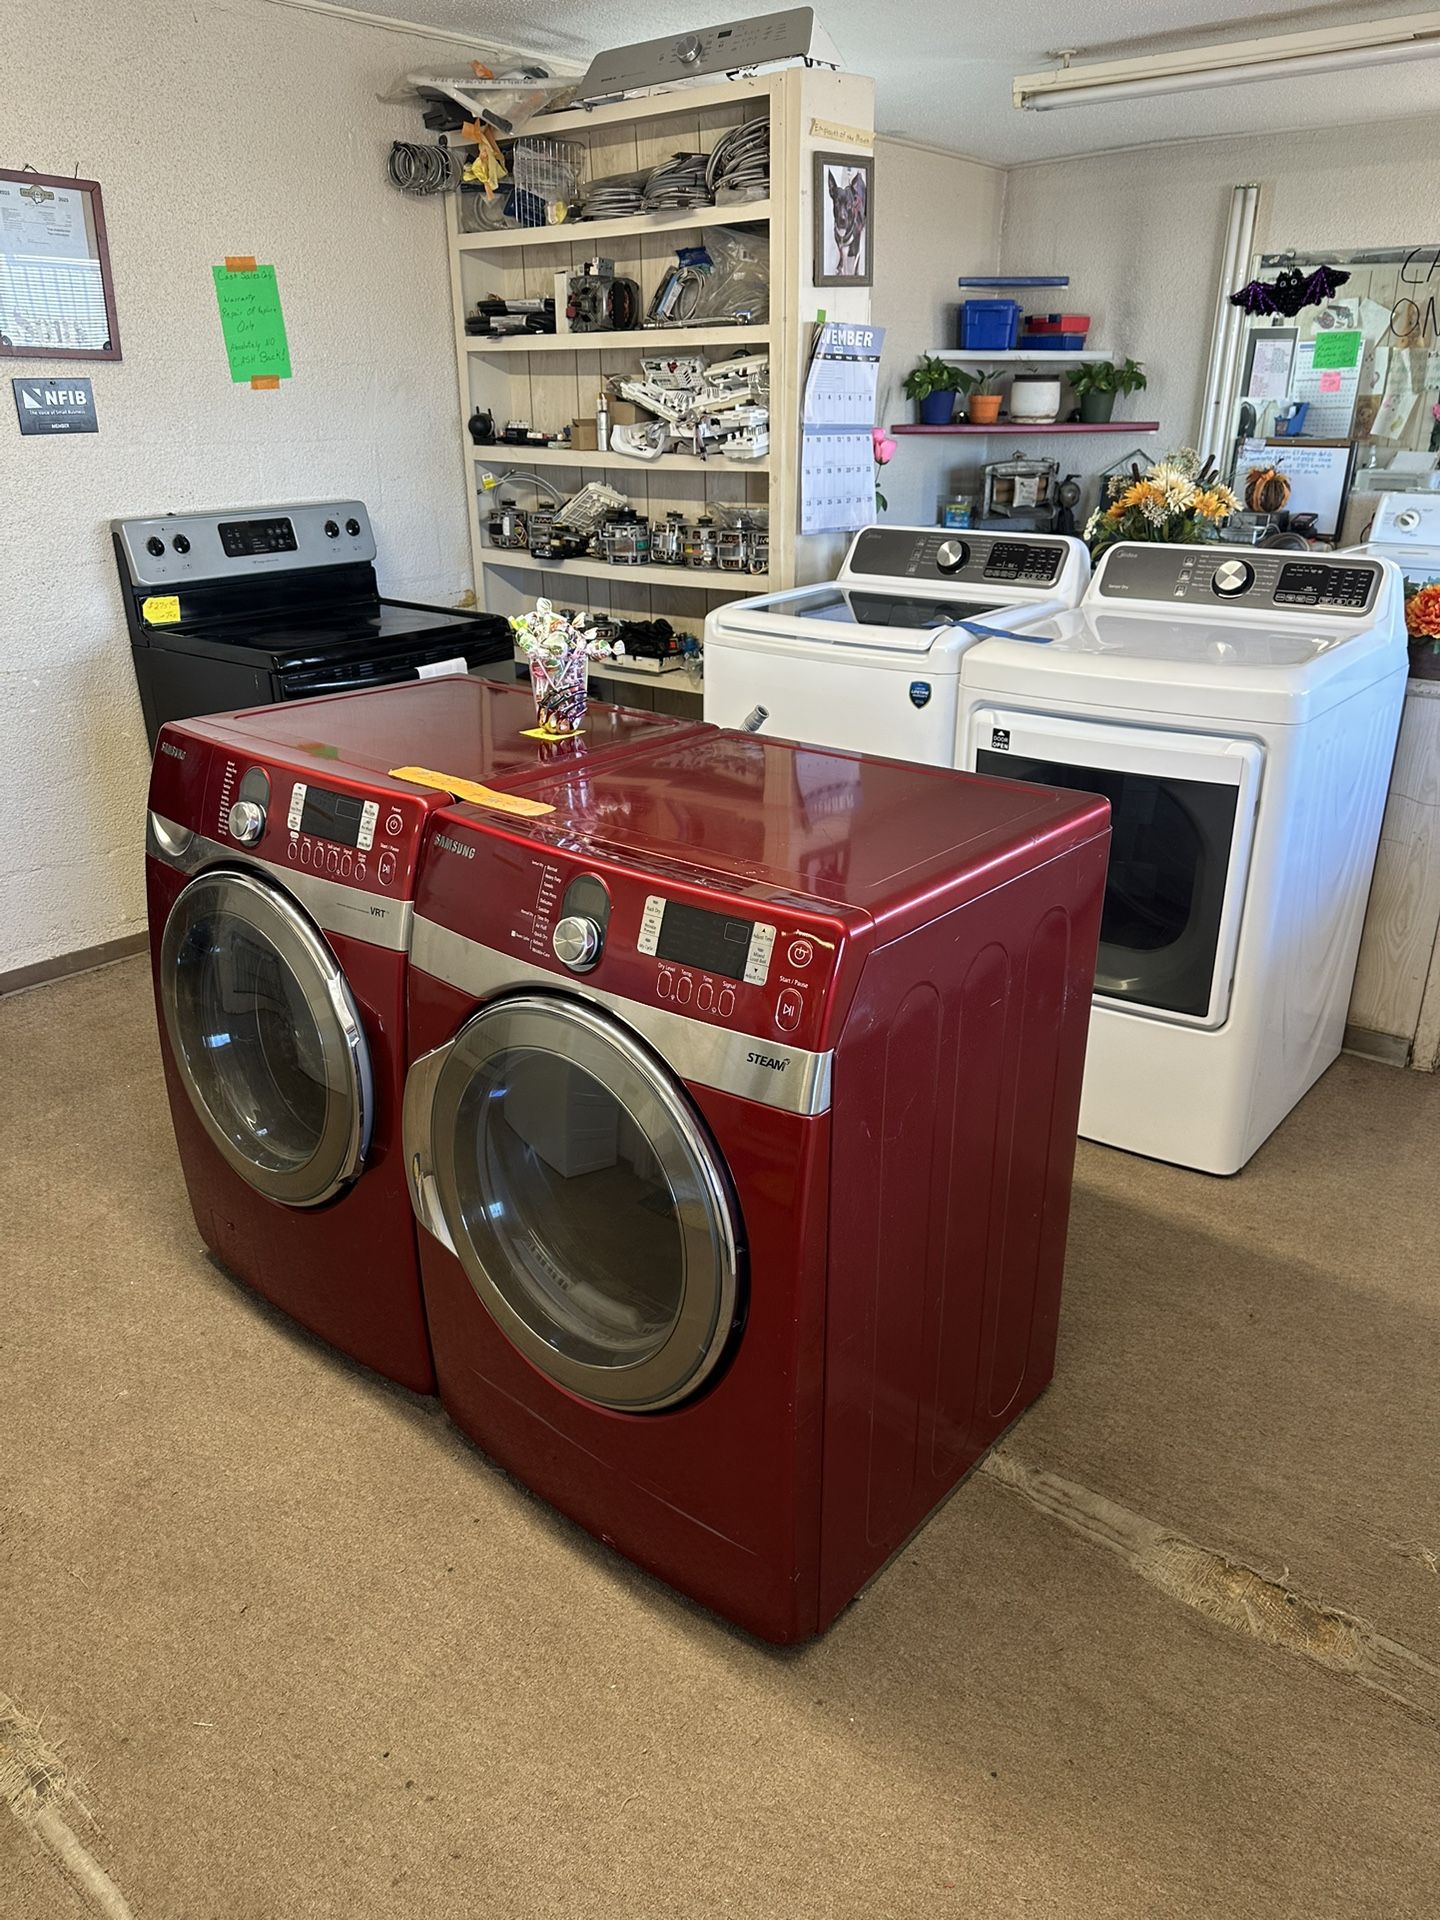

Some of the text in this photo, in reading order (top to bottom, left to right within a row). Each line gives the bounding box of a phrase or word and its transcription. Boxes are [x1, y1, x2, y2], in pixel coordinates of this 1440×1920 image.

[821, 328, 874, 347] VEMBER
[44, 390, 87, 405] NFIB
[994, 735, 1009, 743] DOOR
[992, 742, 1008, 750] OPEN
[434, 833, 476, 859] SAMSUNG
[370, 906, 386, 918] VRT
[703, 976, 713, 984] Time
[723, 980, 737, 990] Signal
[780, 975, 791, 984] Start
[794, 980, 809, 989] Pause
[747, 1052, 785, 1071] STEAM
